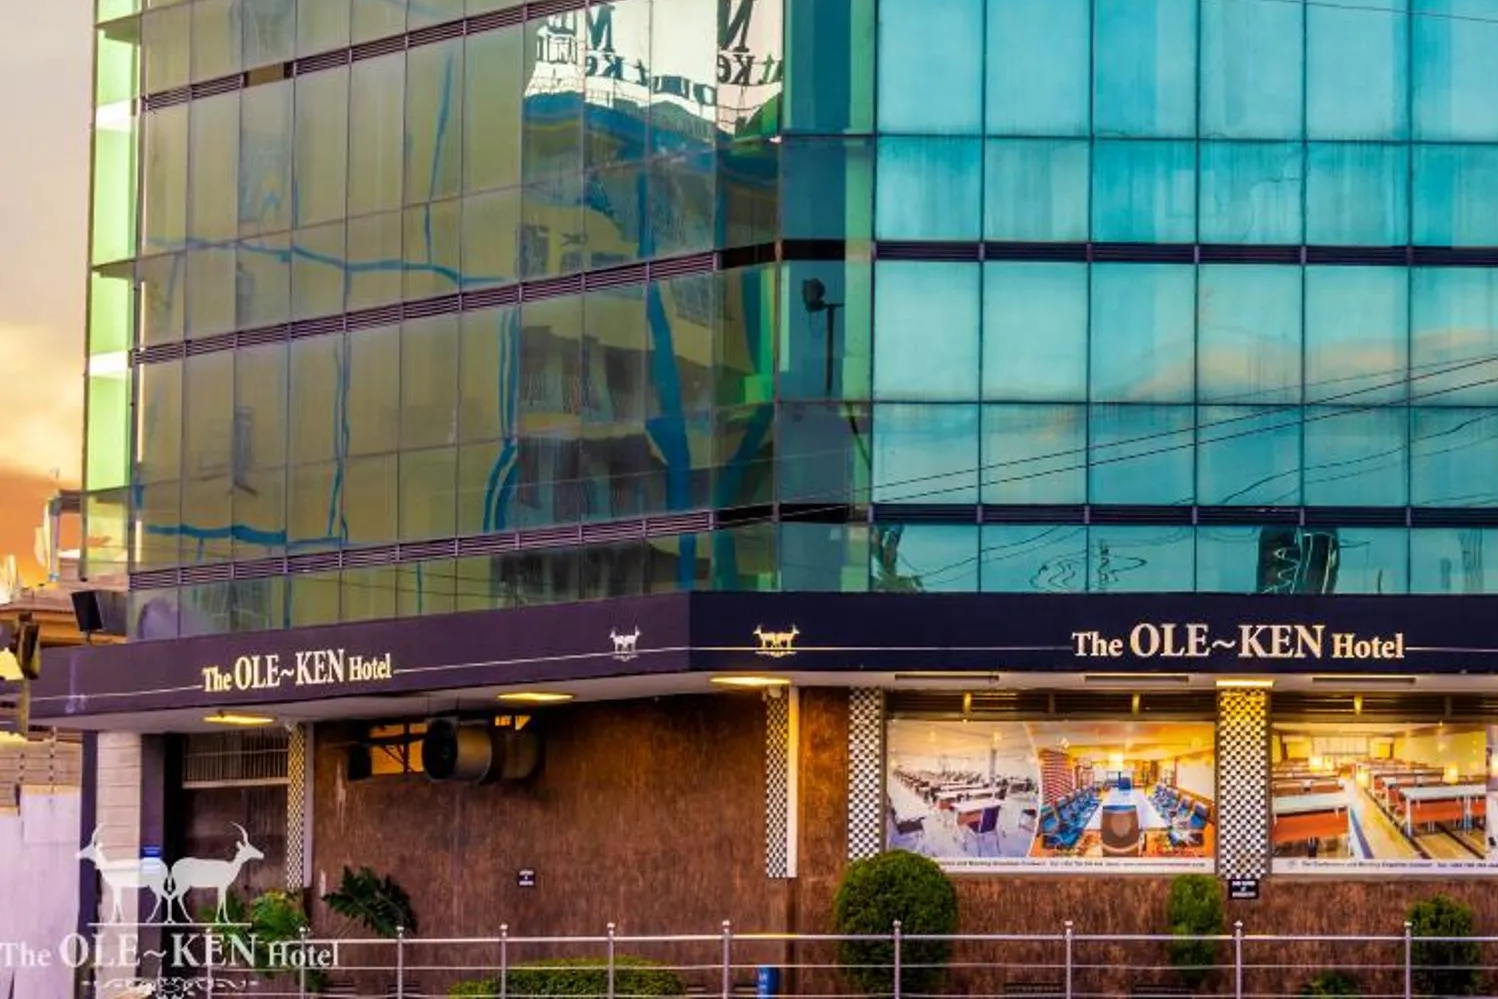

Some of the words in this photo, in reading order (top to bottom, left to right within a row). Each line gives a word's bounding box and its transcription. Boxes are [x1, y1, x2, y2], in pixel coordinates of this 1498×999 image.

[1072, 632, 1123, 657] The
[1129, 623, 1326, 658] OLE~KEN
[1331, 633, 1404, 658] Hotel
[203, 666, 232, 692] The
[235, 649, 345, 690] OLE~KEN
[349, 653, 392, 681] Hotel
